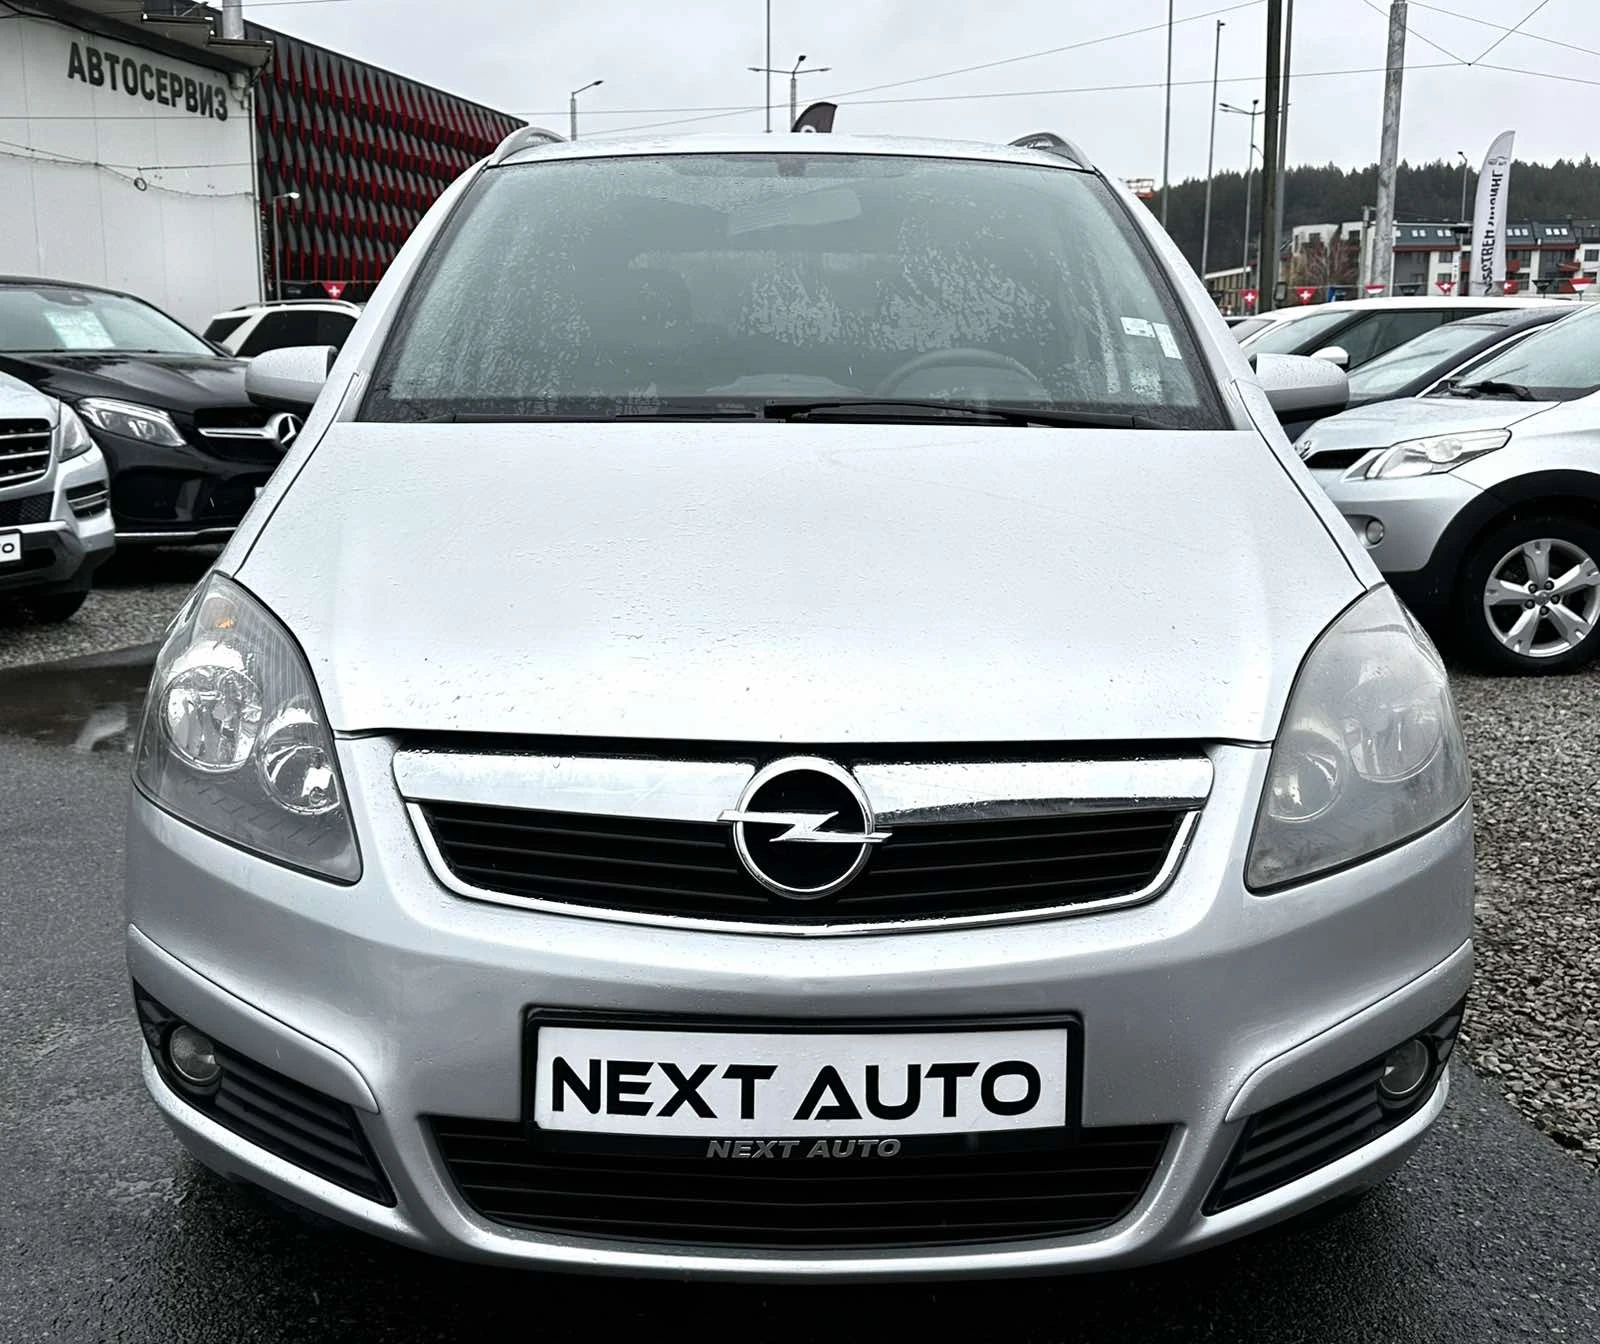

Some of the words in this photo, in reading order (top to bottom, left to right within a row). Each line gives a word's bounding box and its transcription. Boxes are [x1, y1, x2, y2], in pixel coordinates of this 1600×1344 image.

[67, 41, 228, 121] АВТОСЕРВИЗ
[552, 1056, 778, 1120] NEXT
[793, 1060, 1041, 1120] AUTO
[706, 1140, 800, 1159] NEXT
[806, 1138, 901, 1158] AUTO
